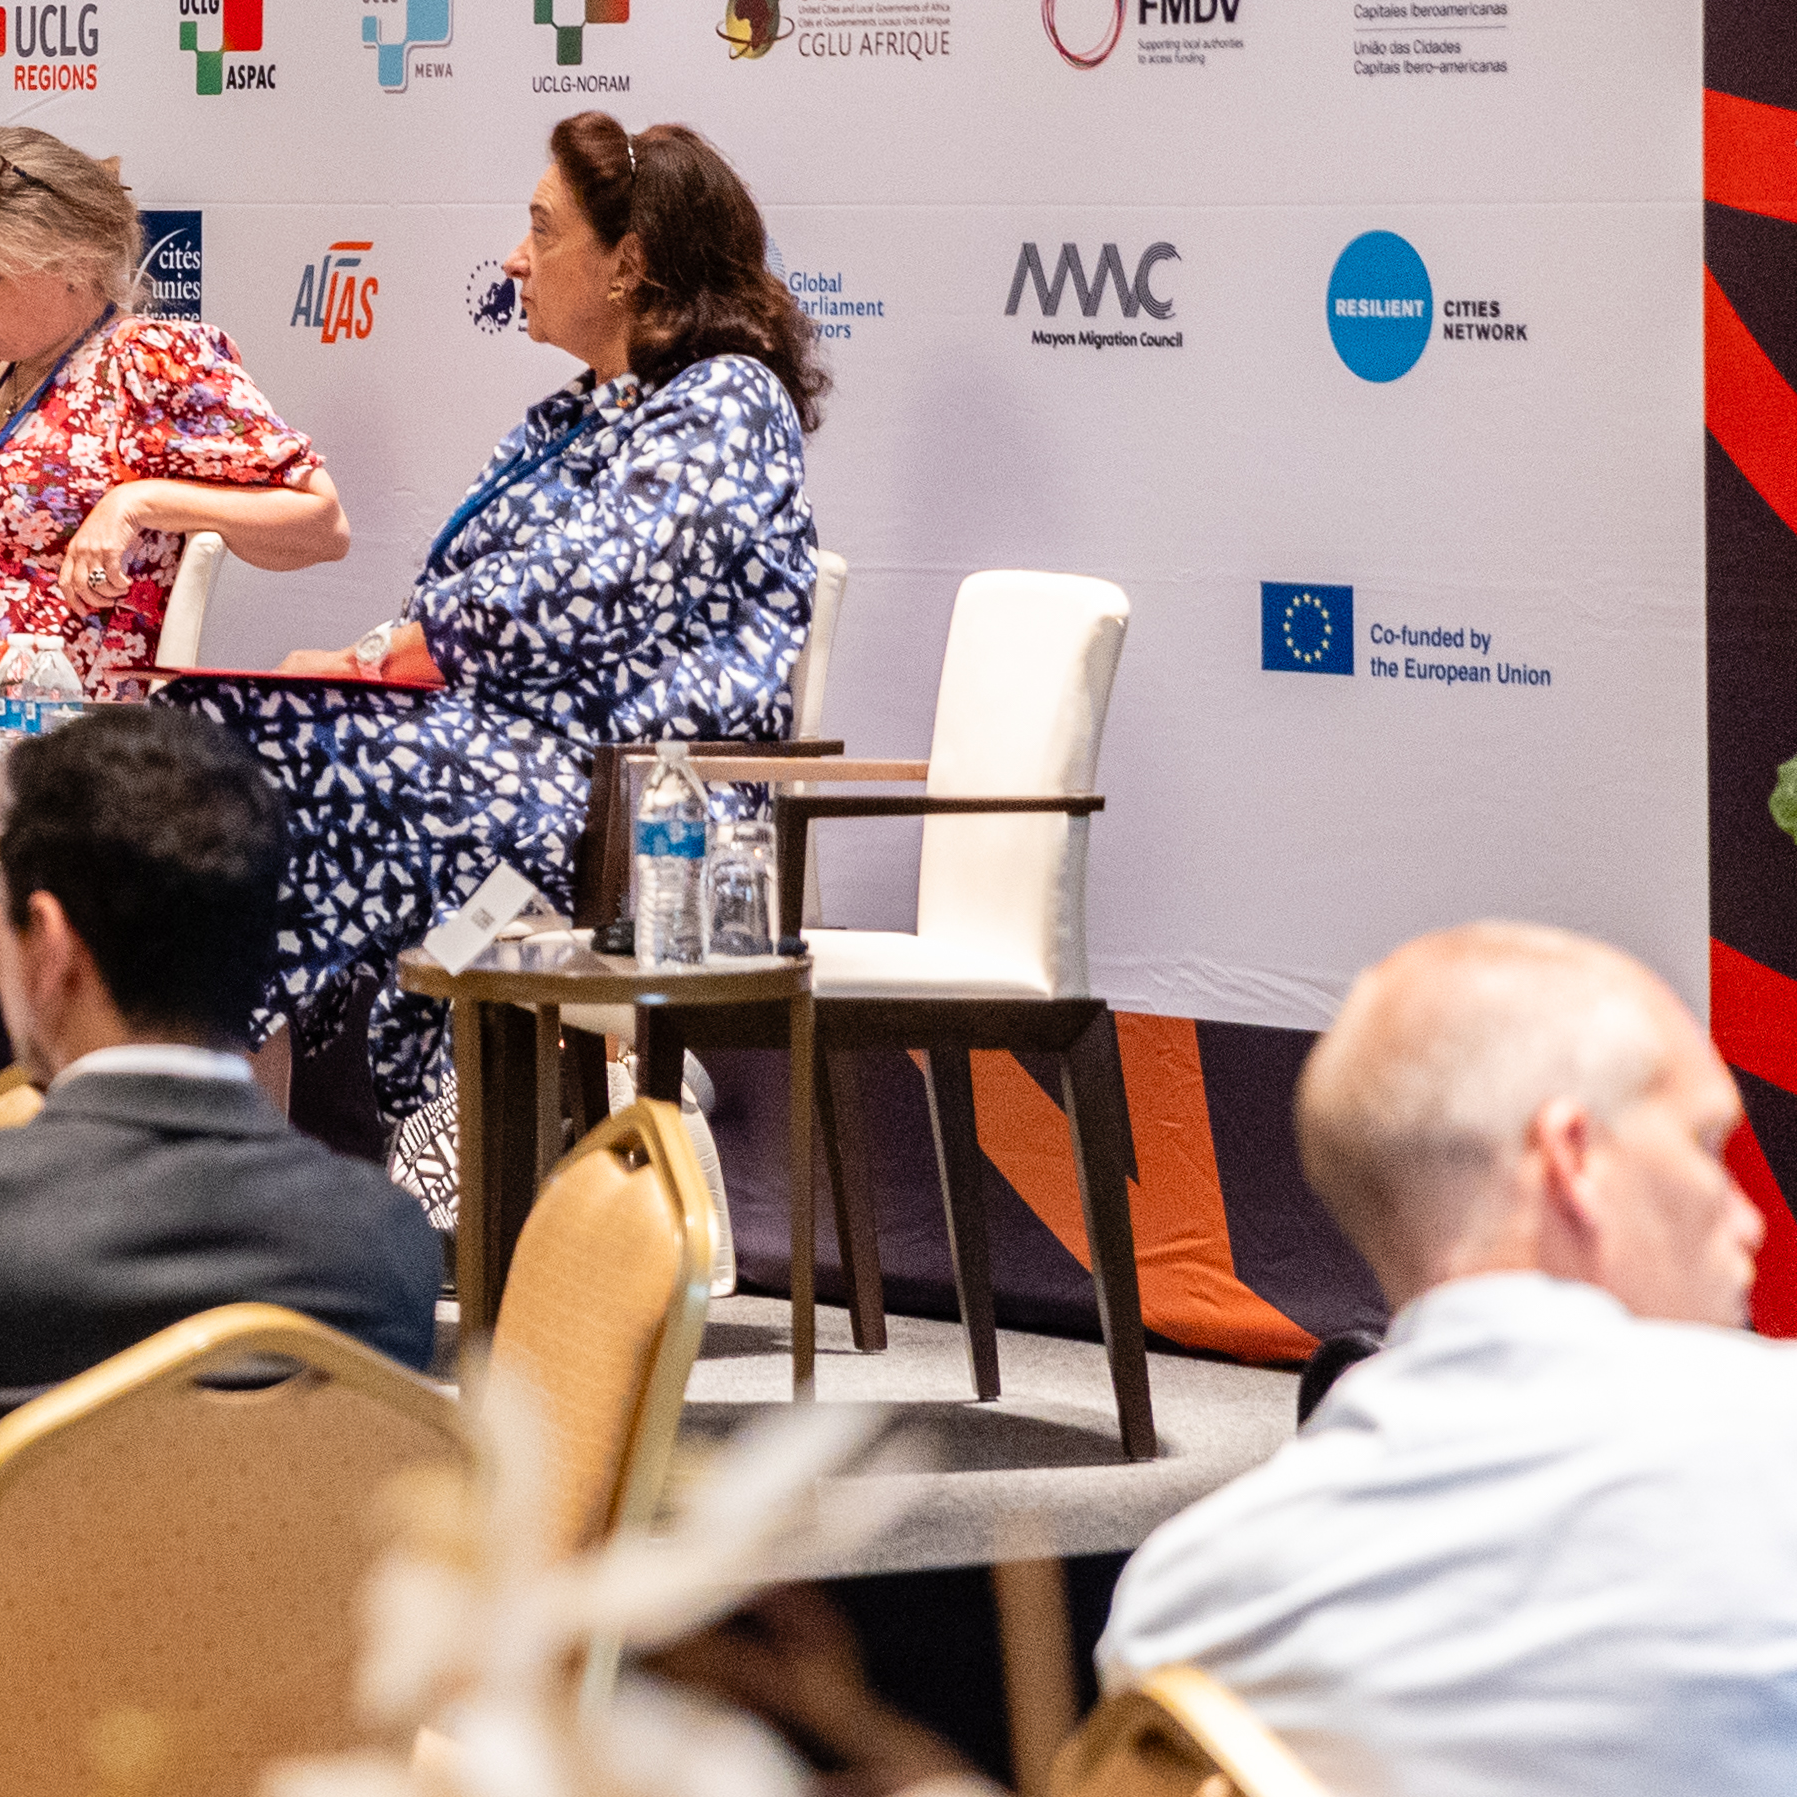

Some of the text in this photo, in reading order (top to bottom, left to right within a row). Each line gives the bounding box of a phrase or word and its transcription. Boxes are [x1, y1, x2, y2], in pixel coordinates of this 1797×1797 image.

[1354, 3, 1507, 19] Capitales Iberoamericanas
[15, 3, 99, 58] UCLG
[798, 31, 950, 61] CGLU AFRIQUE
[1390, 40, 1410, 54] das
[1413, 39, 1461, 54] Cidades
[14, 64, 98, 92] REGIONS
[226, 64, 276, 90] ASPAC
[414, 63, 454, 79] MEWA
[1354, 60, 1507, 76] Capitais Ibero-americanas
[532, 75, 630, 94] UCLG-NORAM
[159, 240, 201, 269] cités
[152, 272, 201, 299] unies
[789, 271, 842, 293] Global
[798, 295, 884, 317] arliament
[1335, 299, 1425, 319] RESILIENT
[1444, 300, 1500, 318] CITIES
[1031, 330, 1183, 350] Mayors Migration Council
[1443, 323, 1527, 341] NETWORK
[1370, 623, 1491, 654] Co-funded by
[1370, 657, 1552, 686] the European Union
